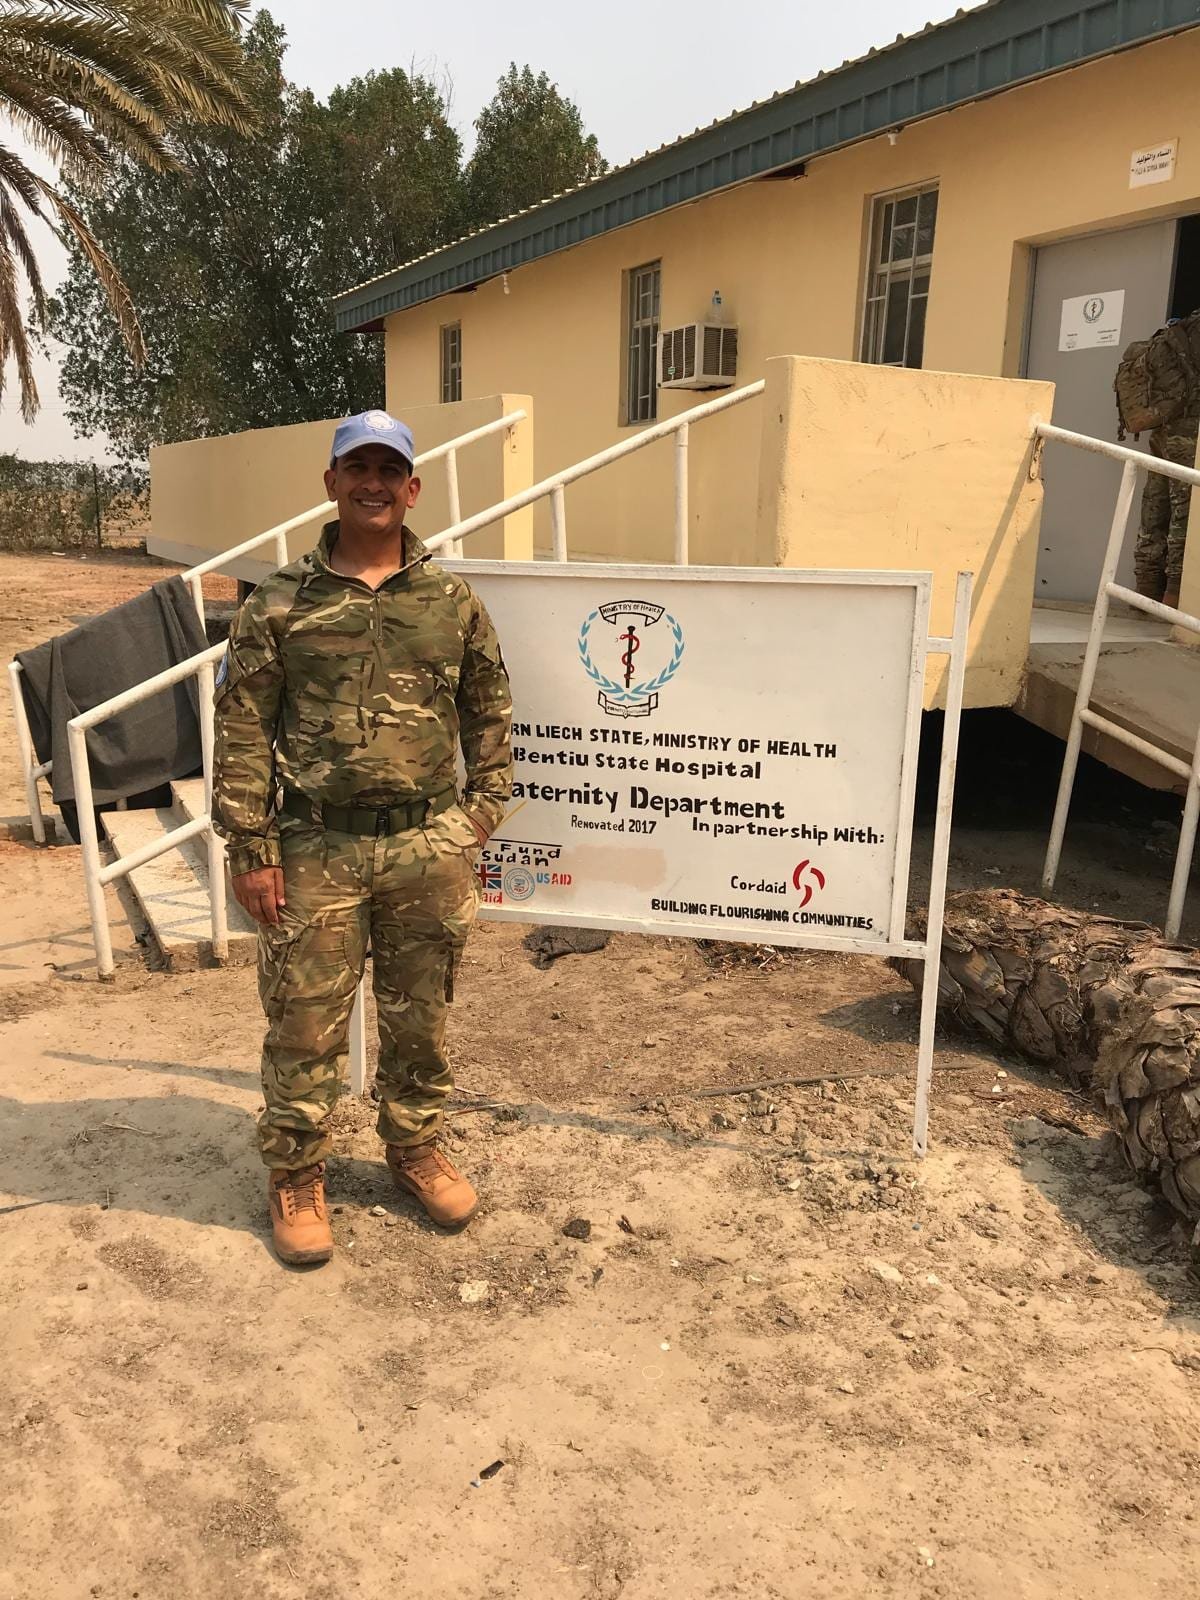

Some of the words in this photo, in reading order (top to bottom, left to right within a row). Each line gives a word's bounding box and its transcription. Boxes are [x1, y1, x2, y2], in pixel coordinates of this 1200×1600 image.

[511, 722, 531, 737] RN
[536, 725, 582, 741] LIECH
[653, 733, 732, 751] MINISTRY
[738, 738, 760, 753] OF
[767, 740, 837, 758] HEALTH
[513, 746, 589, 766] Bentiu
[595, 752, 649, 770] State
[656, 758, 761, 779] Hospital
[511, 781, 618, 813] aternity
[630, 786, 785, 819] Department
[571, 814, 625, 832] Renovated
[628, 818, 657, 834] 2017
[833, 826, 885, 844] With:
[481, 850, 549, 867] Sudan
[500, 843, 561, 859] Fund
[536, 872, 572, 886] USAID
[731, 875, 787, 894] Cordaid
[651, 898, 707, 915] BUILDING
[710, 904, 789, 923] FLOURISHING
[793, 911, 873, 930] COMMUNITIES
